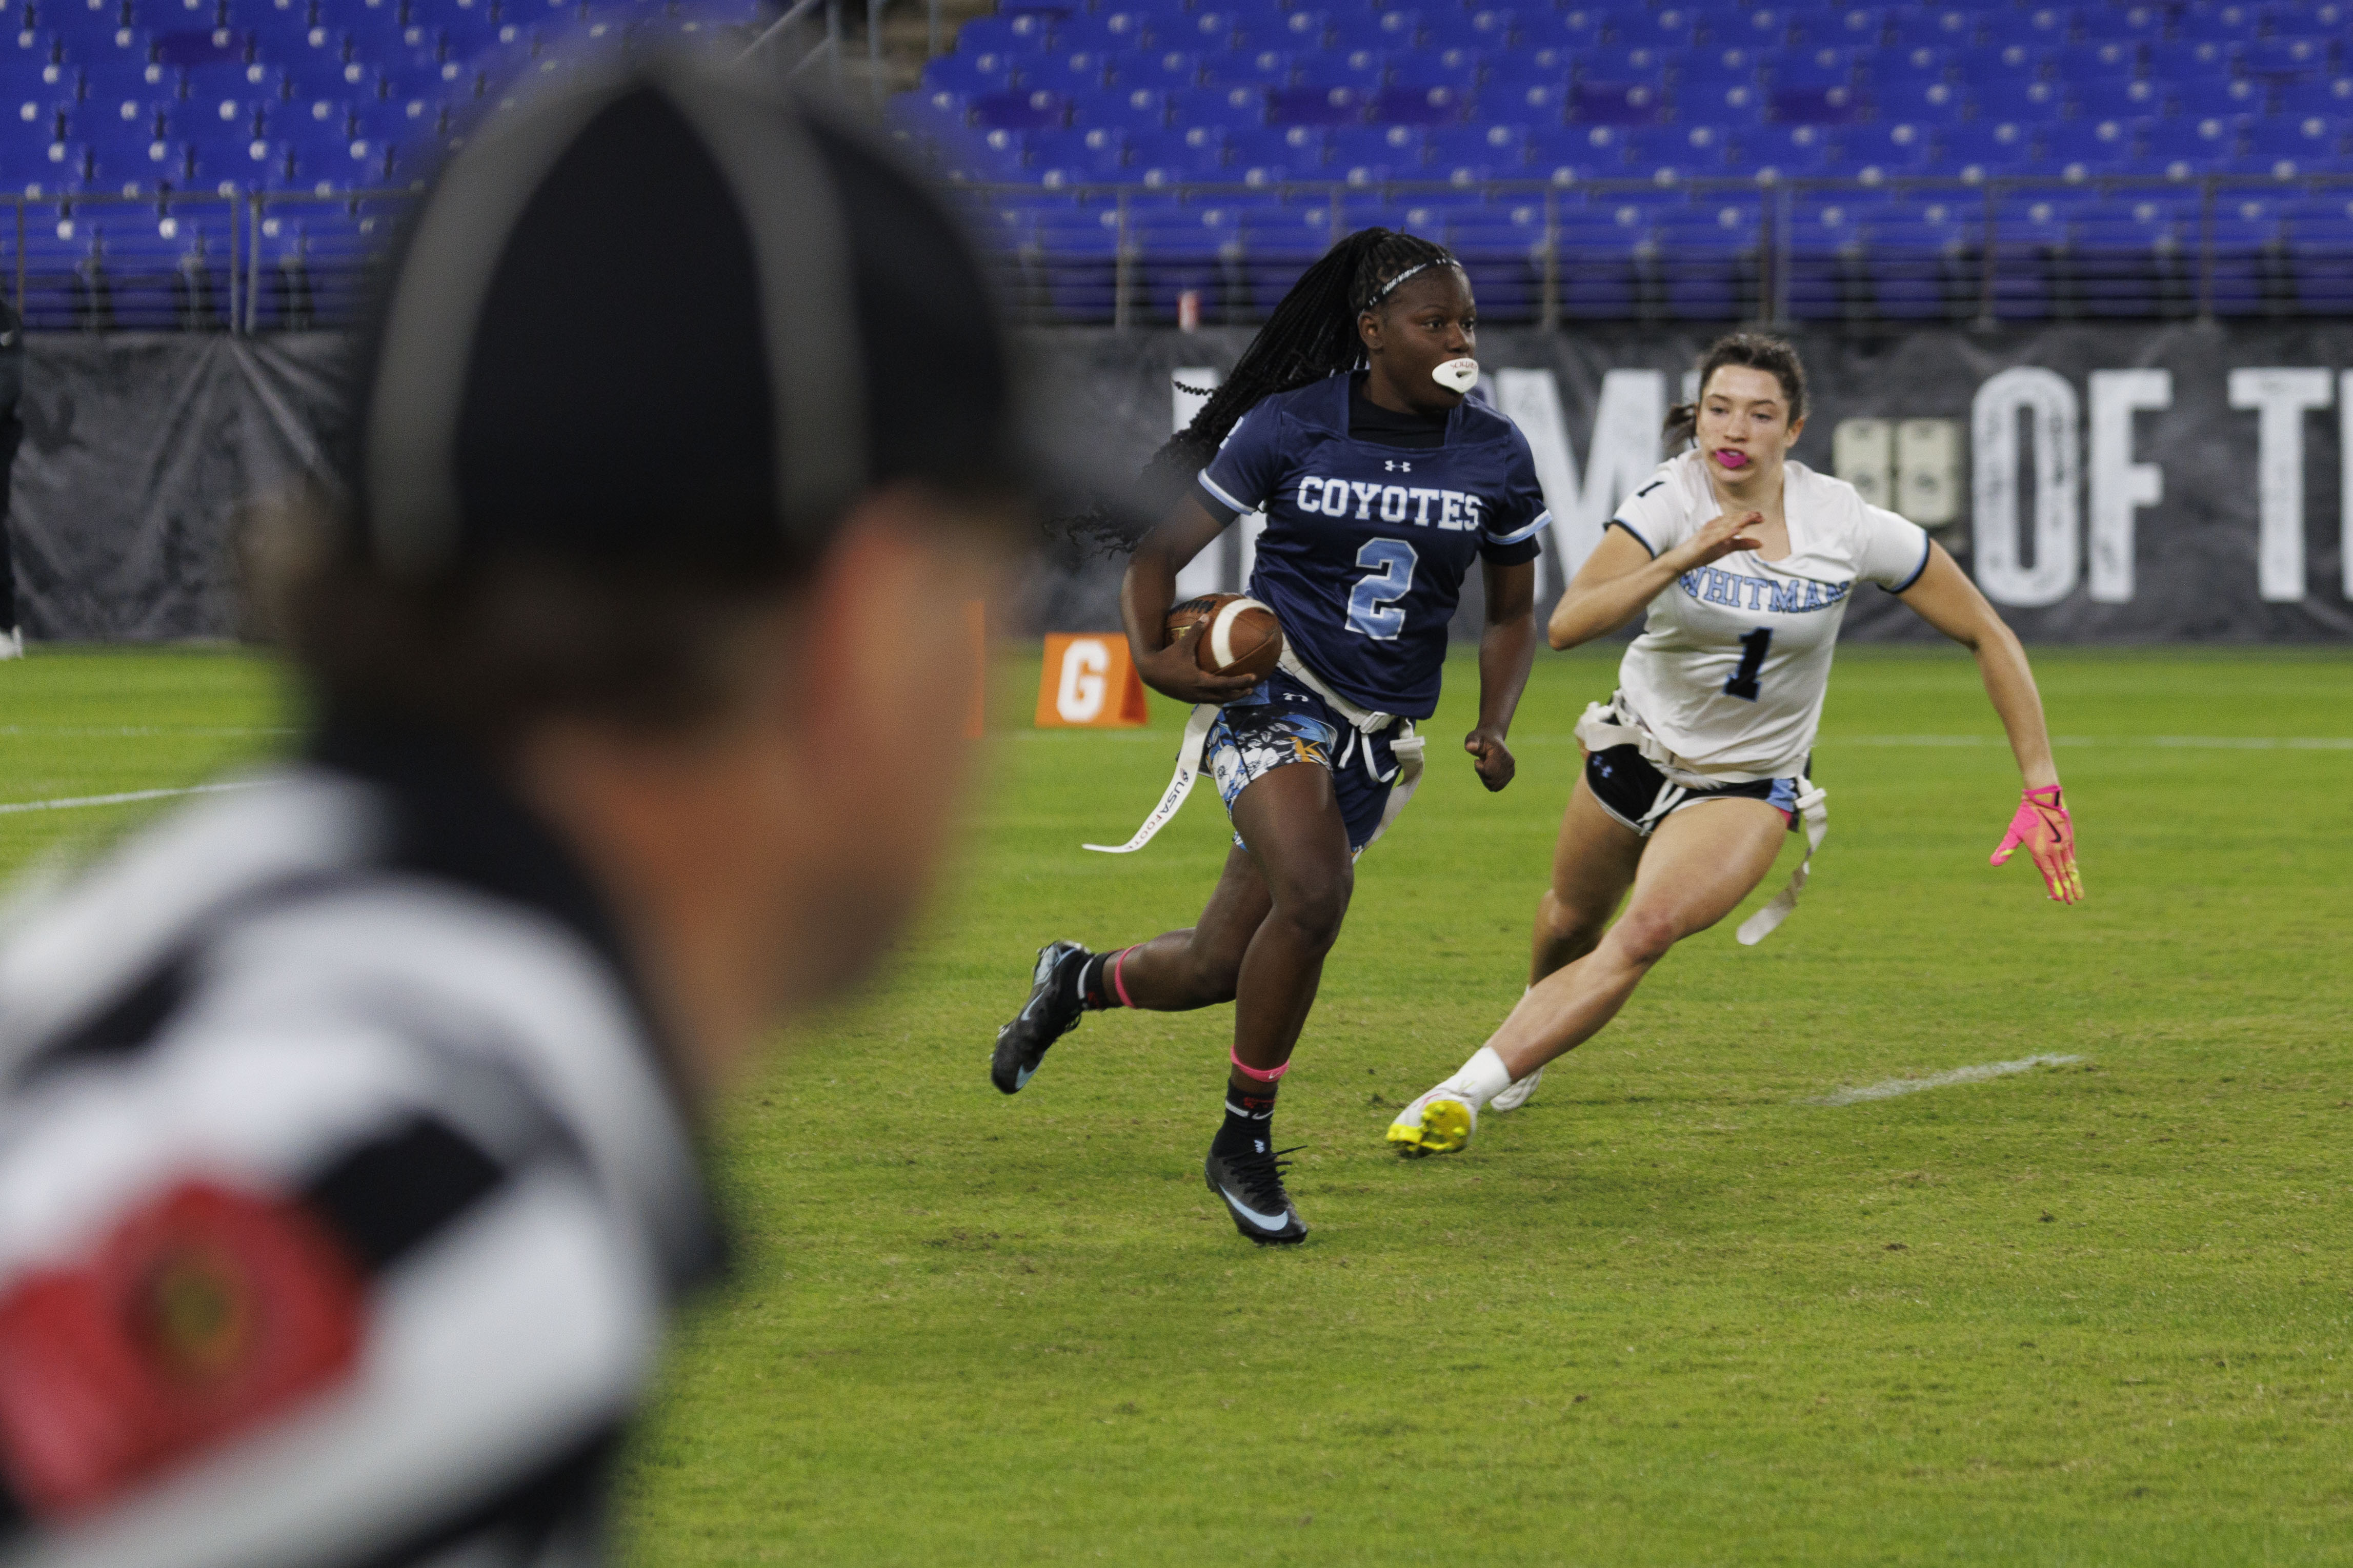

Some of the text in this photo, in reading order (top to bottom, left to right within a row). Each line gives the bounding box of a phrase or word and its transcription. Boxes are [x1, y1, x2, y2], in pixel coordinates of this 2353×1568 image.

[1297, 476, 1482, 531] COYOTES
[1972, 366, 2173, 606] OF
[2228, 367, 2353, 602] T
[1344, 537, 1418, 640] 2
[1056, 639, 1110, 723] G
[1723, 627, 1773, 703] 1
